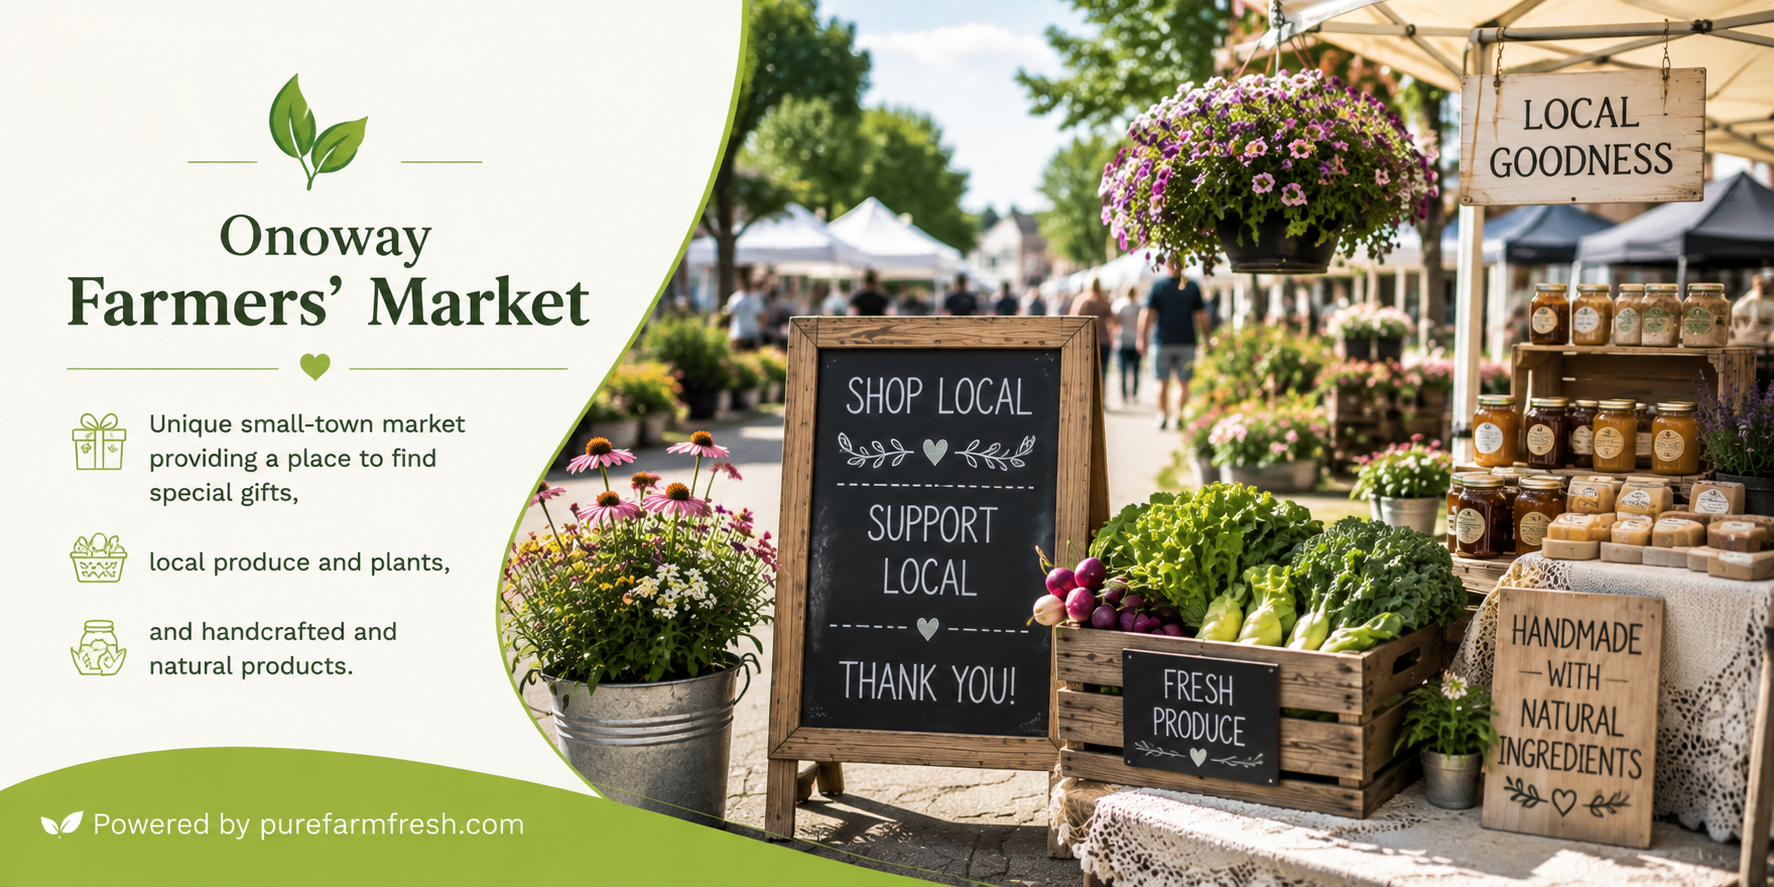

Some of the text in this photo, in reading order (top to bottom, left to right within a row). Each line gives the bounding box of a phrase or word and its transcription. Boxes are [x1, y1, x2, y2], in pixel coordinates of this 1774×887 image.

[1523, 96, 1640, 131] LOCAL
[1489, 141, 1674, 179] GOODNESS
[846, 376, 1033, 415] SHOP LOCAL
[867, 504, 999, 544] SUPPORT
[883, 557, 978, 597] LOCAL
[1512, 614, 1643, 656] HANDMADE
[838, 660, 1016, 705] THANK YOU!
[1164, 668, 1233, 706] FRESH
[1547, 659, 1601, 691] WITH
[1153, 706, 1246, 747] PRODUCE
[1520, 698, 1625, 738] NATURAL
[1498, 735, 1643, 780] INGREDIENTS
